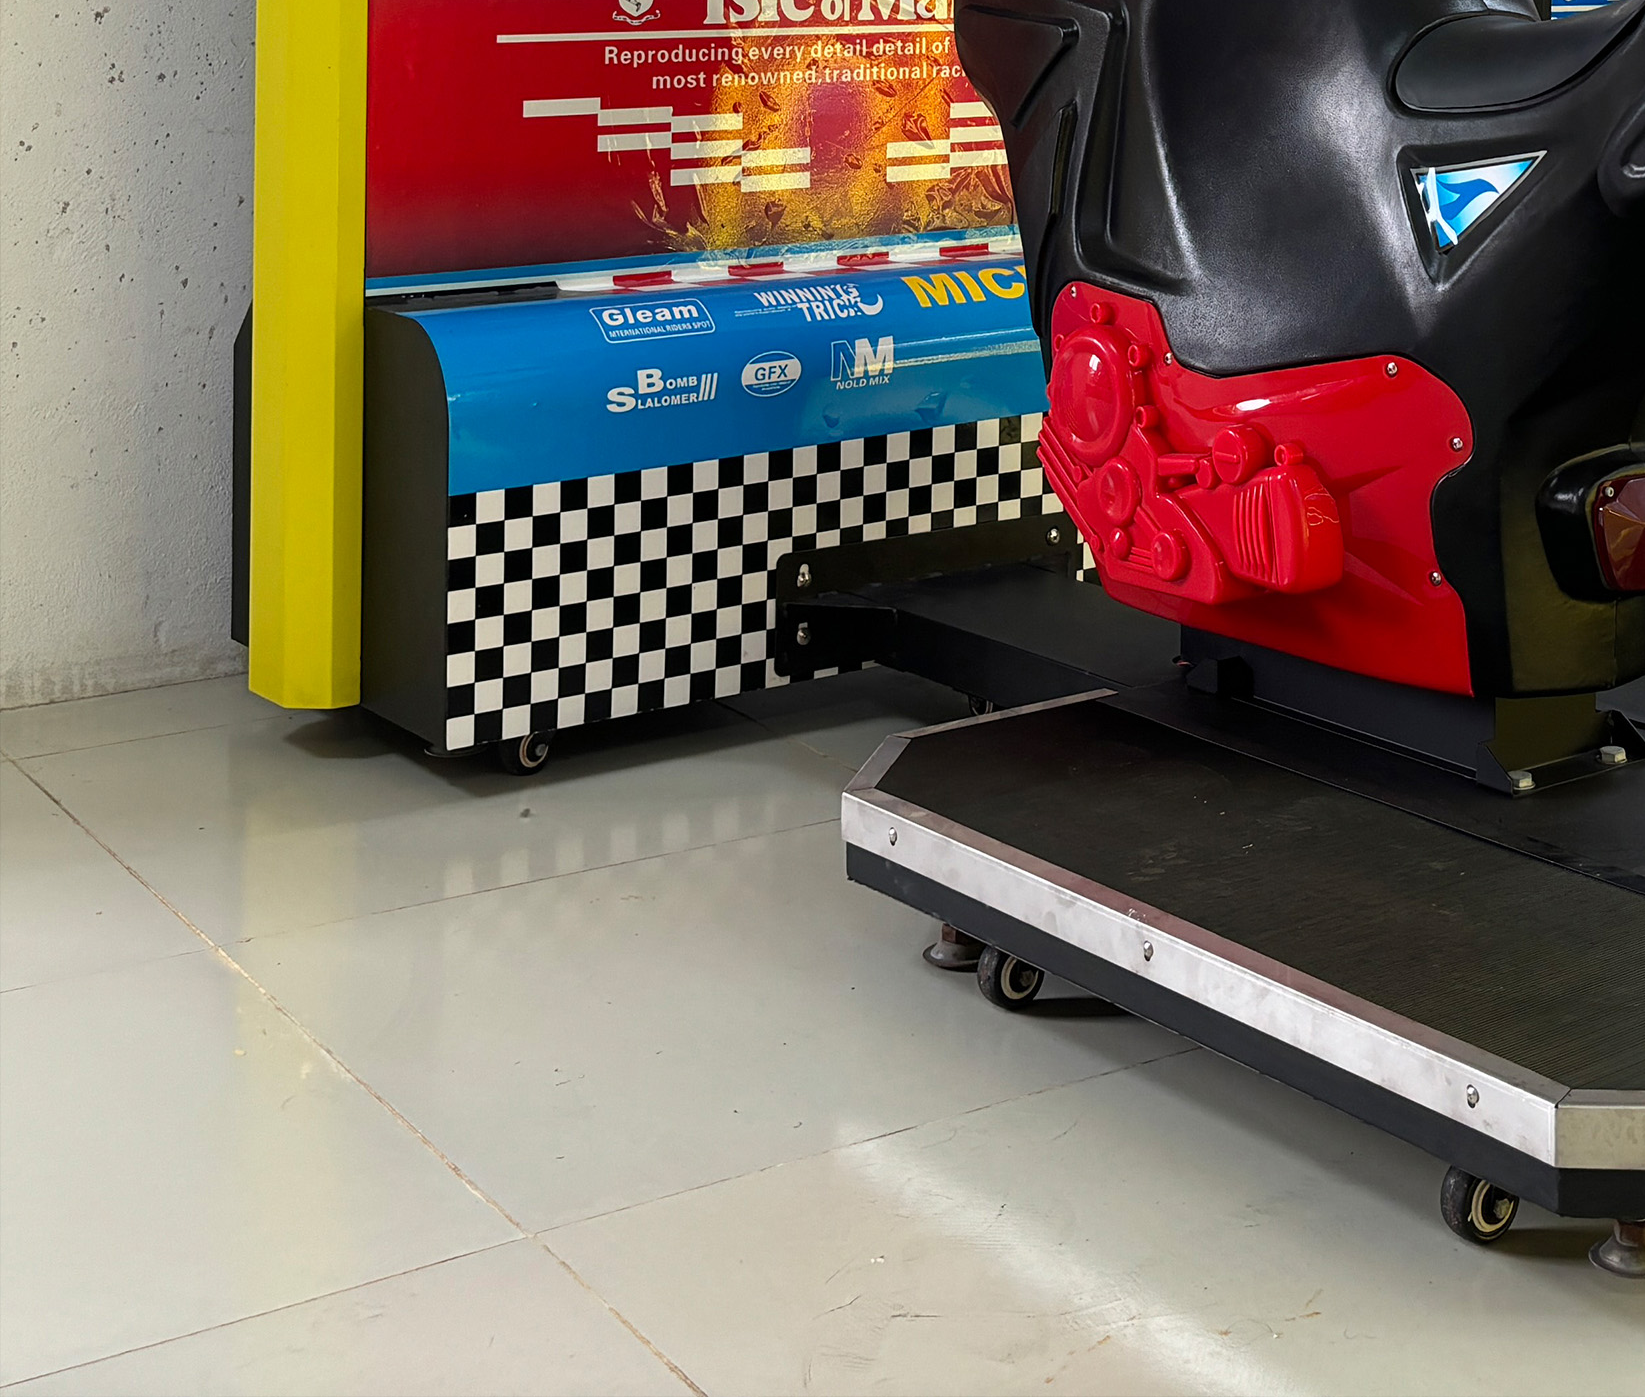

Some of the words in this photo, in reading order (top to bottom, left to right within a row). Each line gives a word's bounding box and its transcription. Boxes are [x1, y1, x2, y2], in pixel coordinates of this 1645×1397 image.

[604, 43, 743, 67] Reproducing
[749, 43, 804, 63] every
[810, 39, 867, 59] detail
[873, 37, 926, 56] detail
[932, 37, 951, 53] of
[652, 70, 706, 90] most
[901, 265, 1027, 308] MIC
[602, 305, 699, 326] Gleam
[755, 364, 789, 381] GFX
[869, 376, 890, 386] MIX
